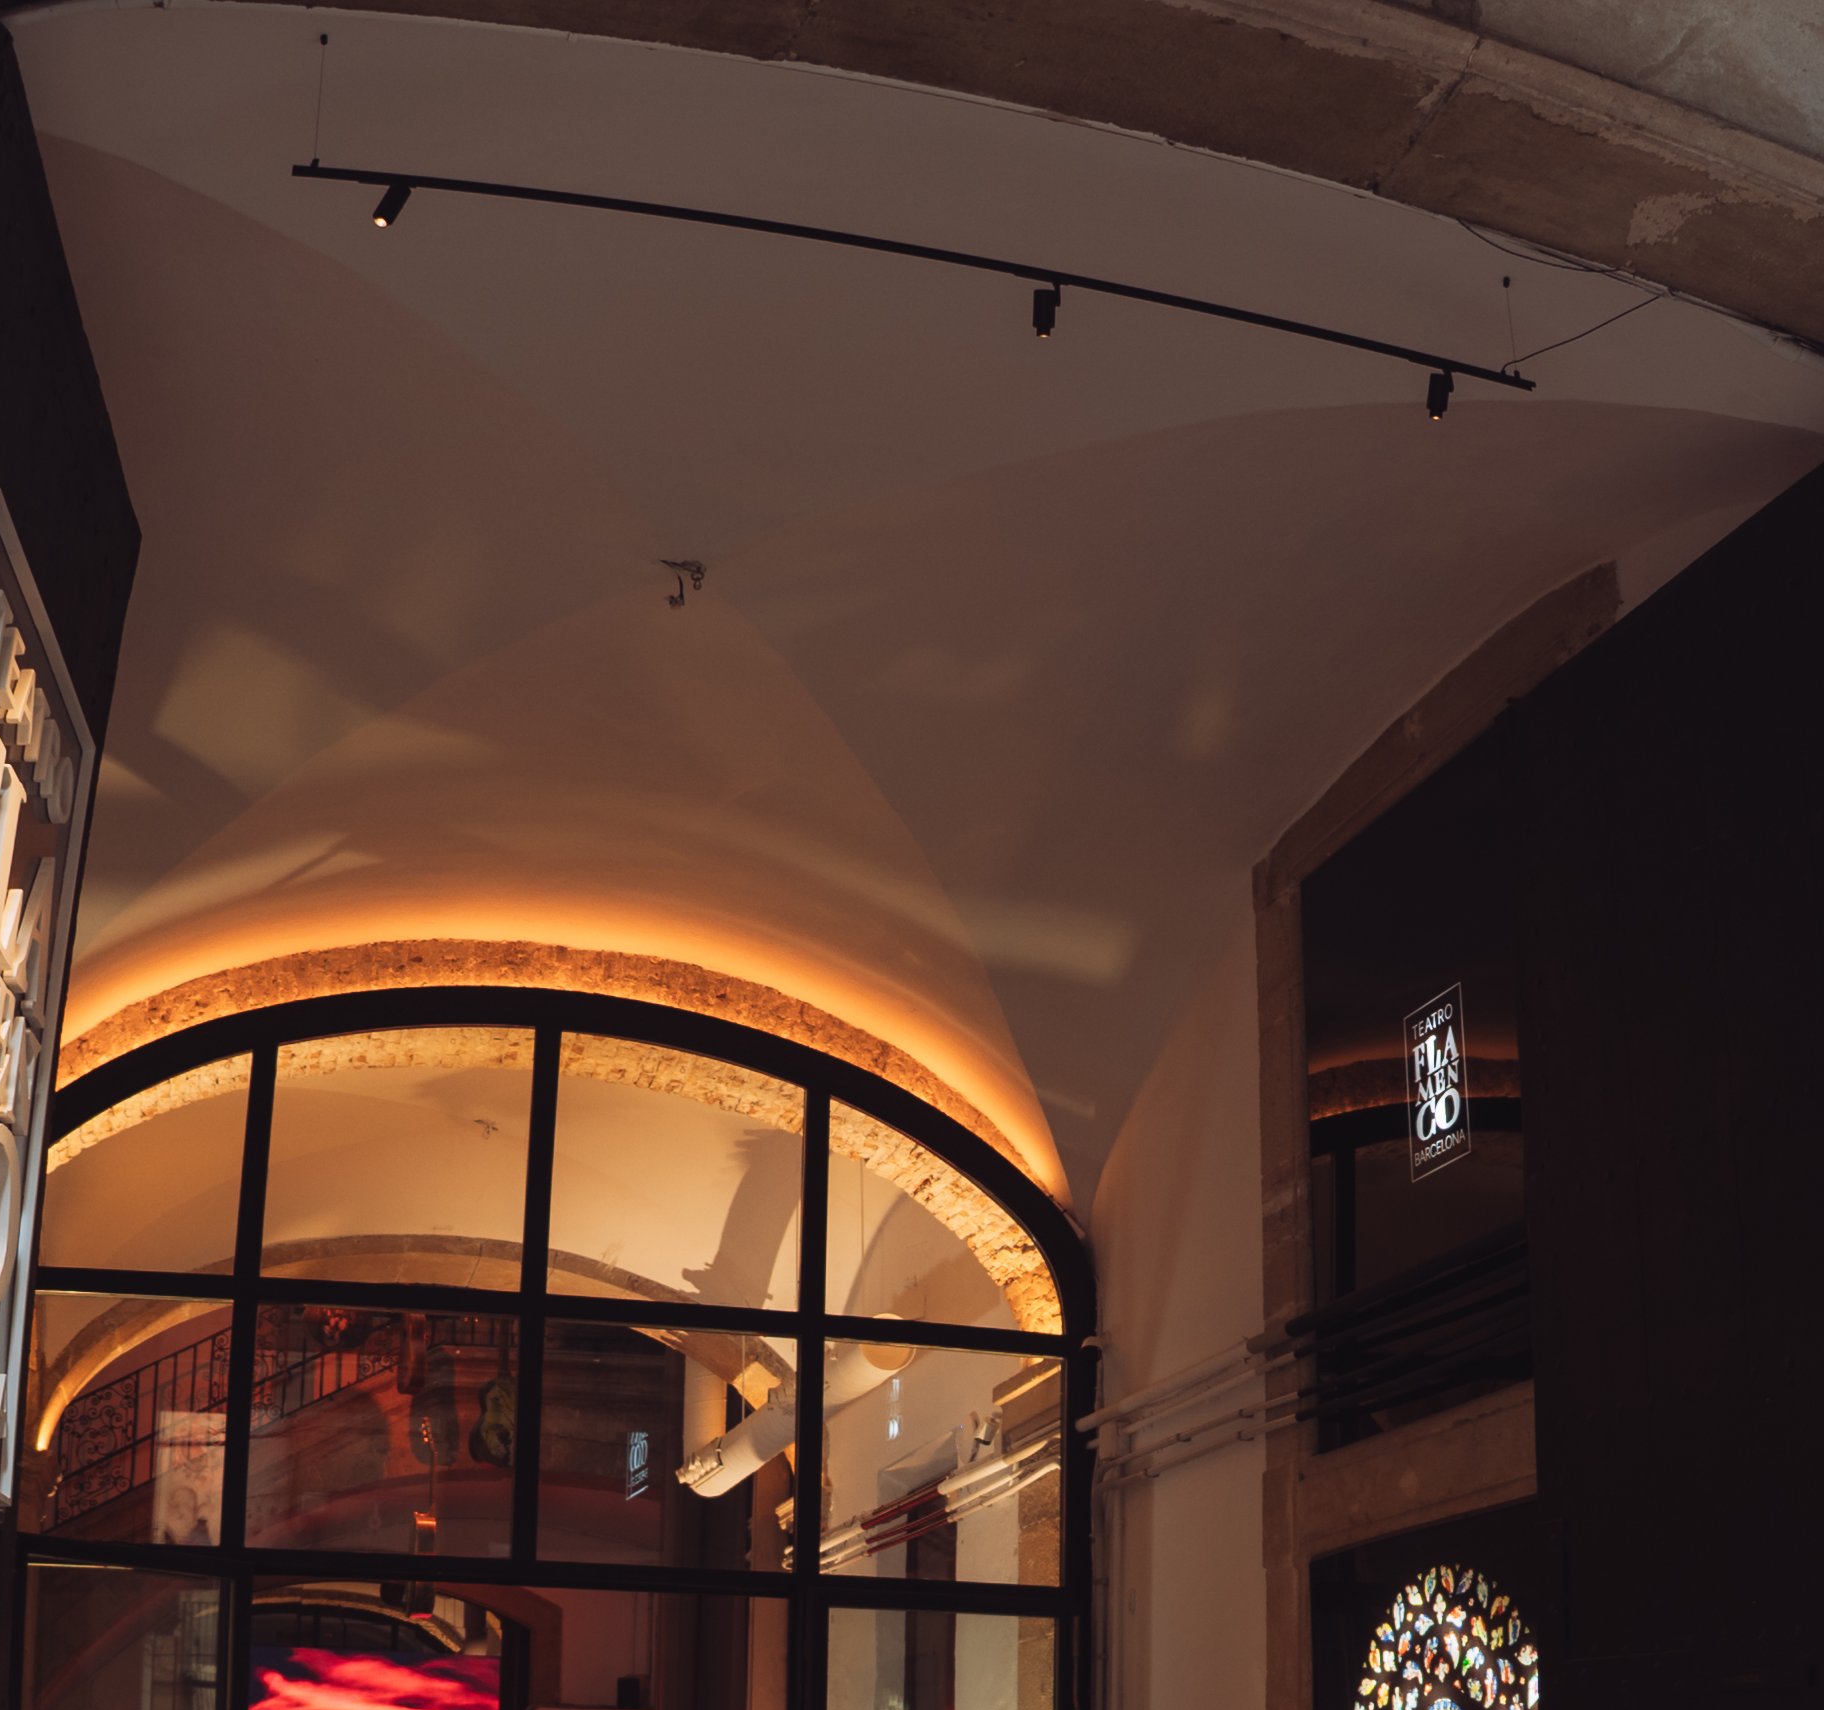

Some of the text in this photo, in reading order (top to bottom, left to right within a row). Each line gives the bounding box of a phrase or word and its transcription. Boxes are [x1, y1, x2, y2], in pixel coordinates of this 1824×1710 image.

[1412, 1003, 1453, 1041] TEATRO
[1412, 1025, 1460, 1083] FLA
[1415, 1059, 1459, 1107] MEN
[1415, 1087, 1461, 1142] CO
[1414, 1128, 1466, 1167] BARCELONA
